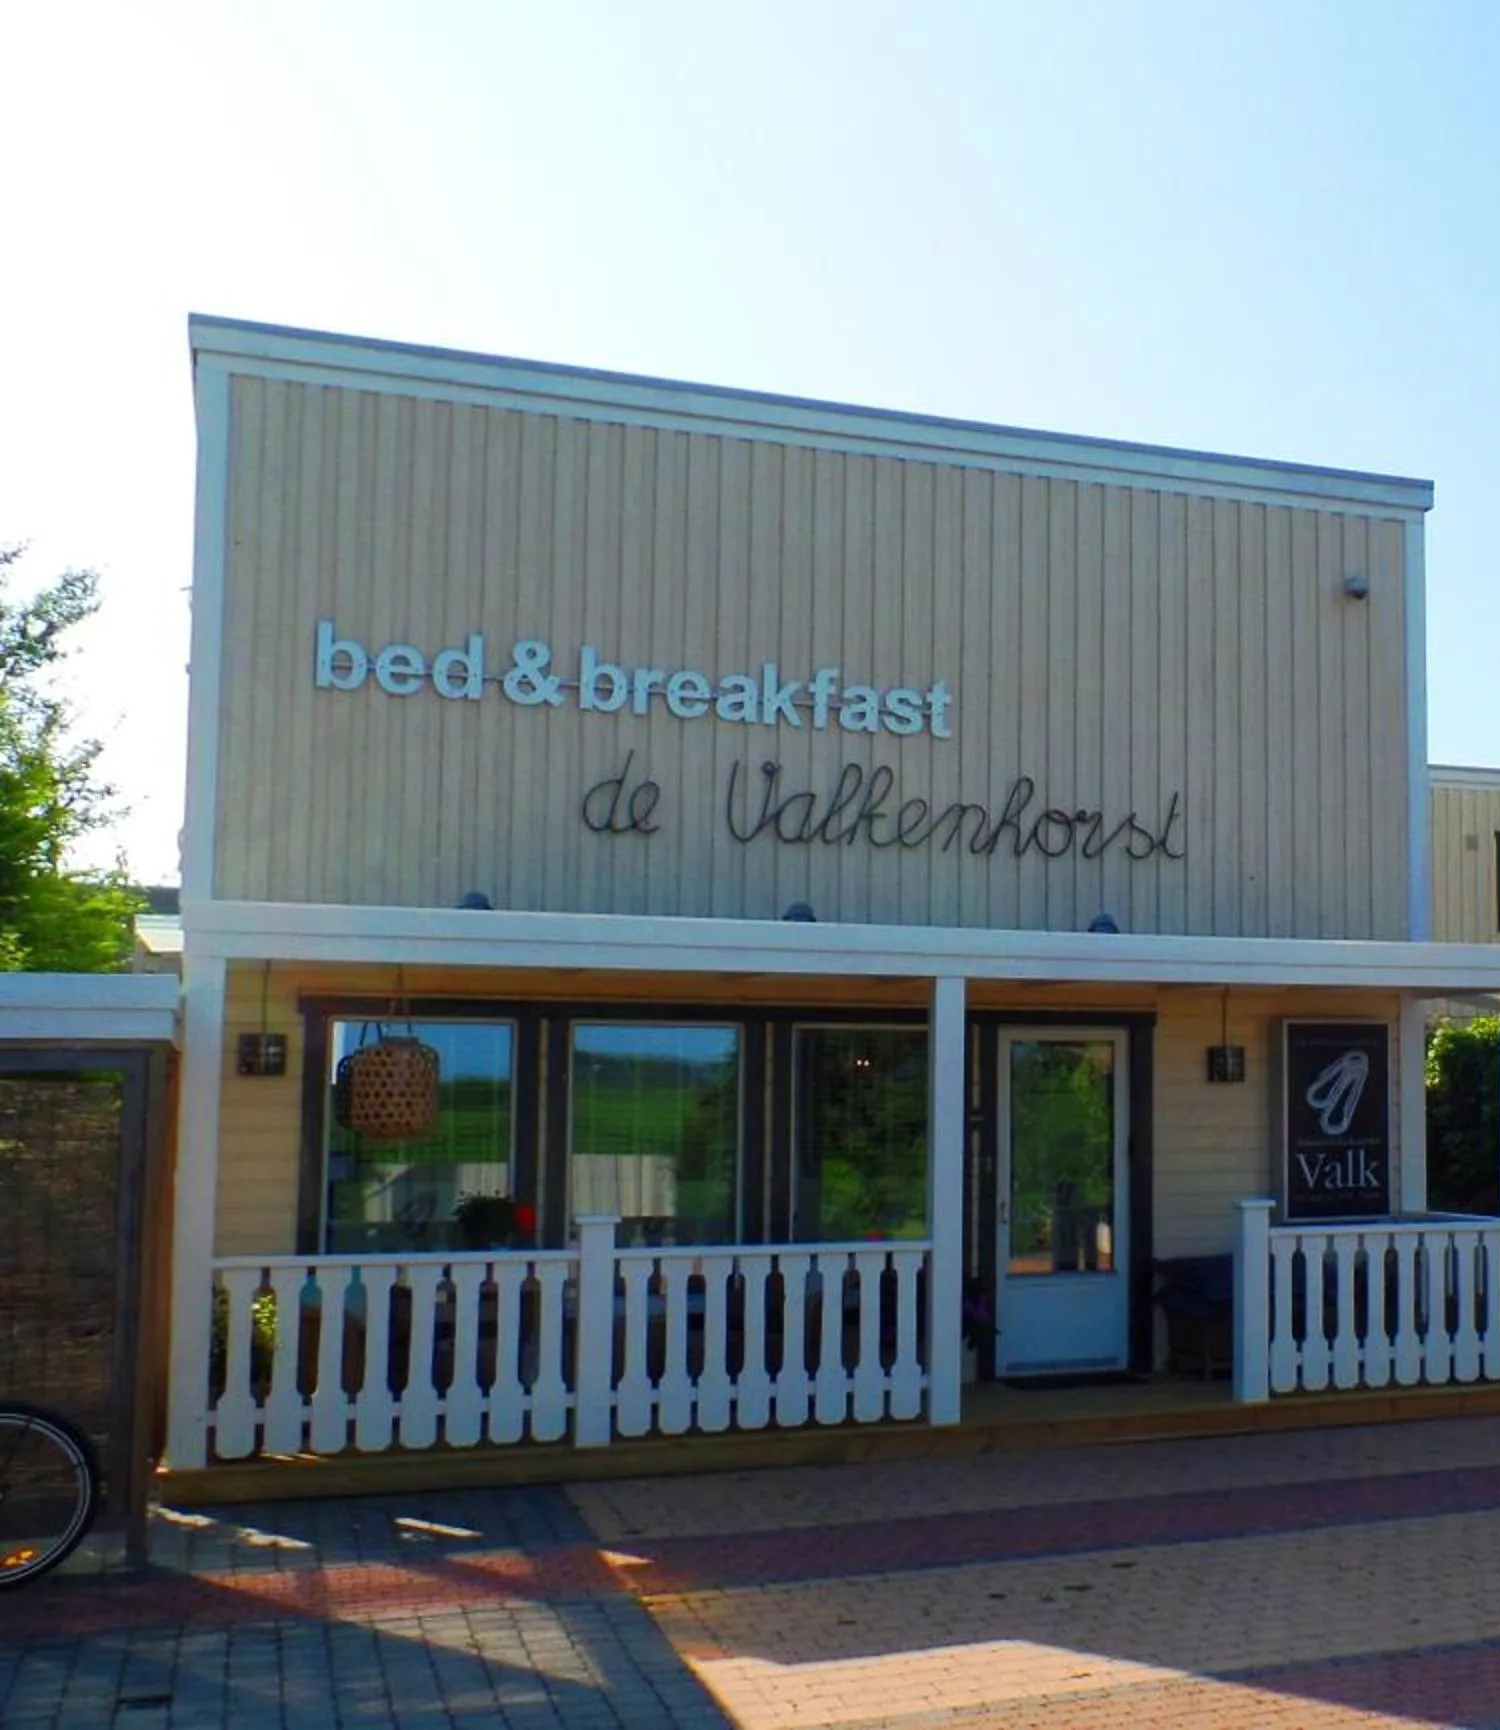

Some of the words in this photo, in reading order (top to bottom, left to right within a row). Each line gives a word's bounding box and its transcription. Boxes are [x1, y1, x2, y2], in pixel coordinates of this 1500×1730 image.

[315, 620, 484, 699] bed
[503, 640, 565, 706] &
[579, 645, 952, 738] breakfast
[582, 749, 660, 834] de
[727, 759, 1186, 859] Valkenhorst
[1296, 1148, 1380, 1190] Valk
